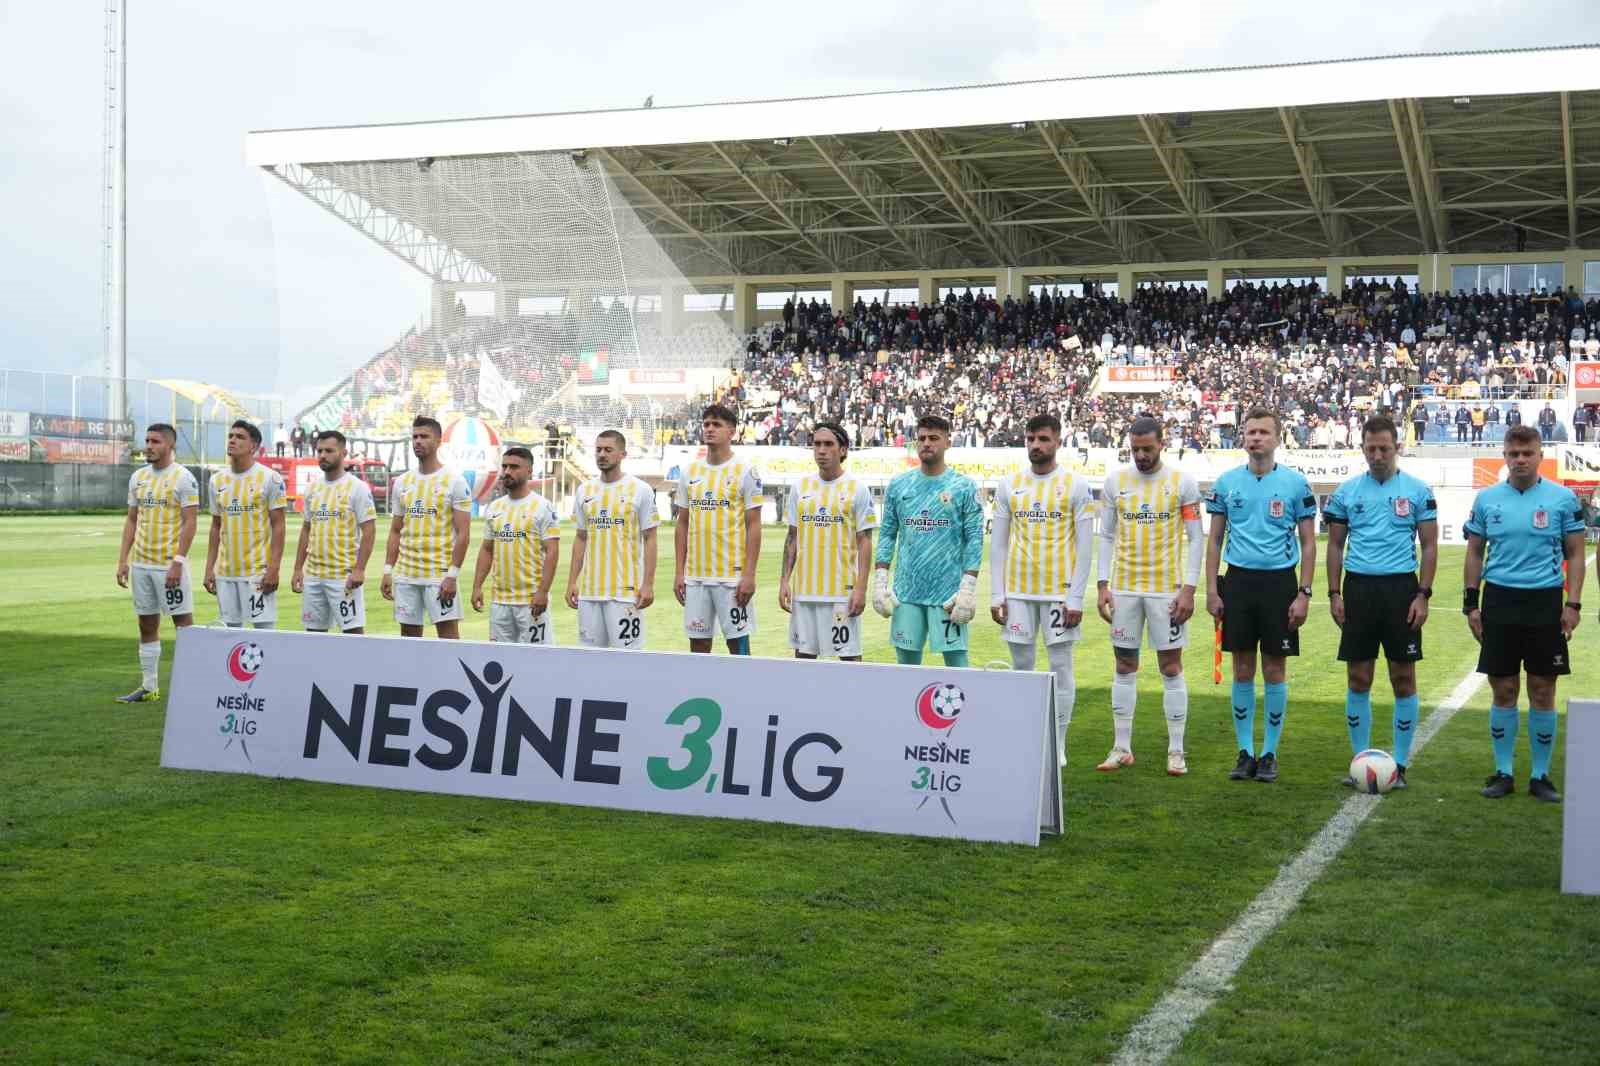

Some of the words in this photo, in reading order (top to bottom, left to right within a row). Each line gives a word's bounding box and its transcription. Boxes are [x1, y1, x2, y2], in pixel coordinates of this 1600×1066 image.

[88, 421, 134, 435] RELAM
[1330, 465, 1348, 475] 49
[166, 589, 183, 605] 99
[249, 594, 265, 611] 14
[340, 600, 357, 617] 61
[730, 607, 748, 625] 94
[1050, 609, 1063, 628] 2
[529, 623, 546, 643] 27
[619, 617, 640, 639] 28
[832, 625, 849, 644] 20
